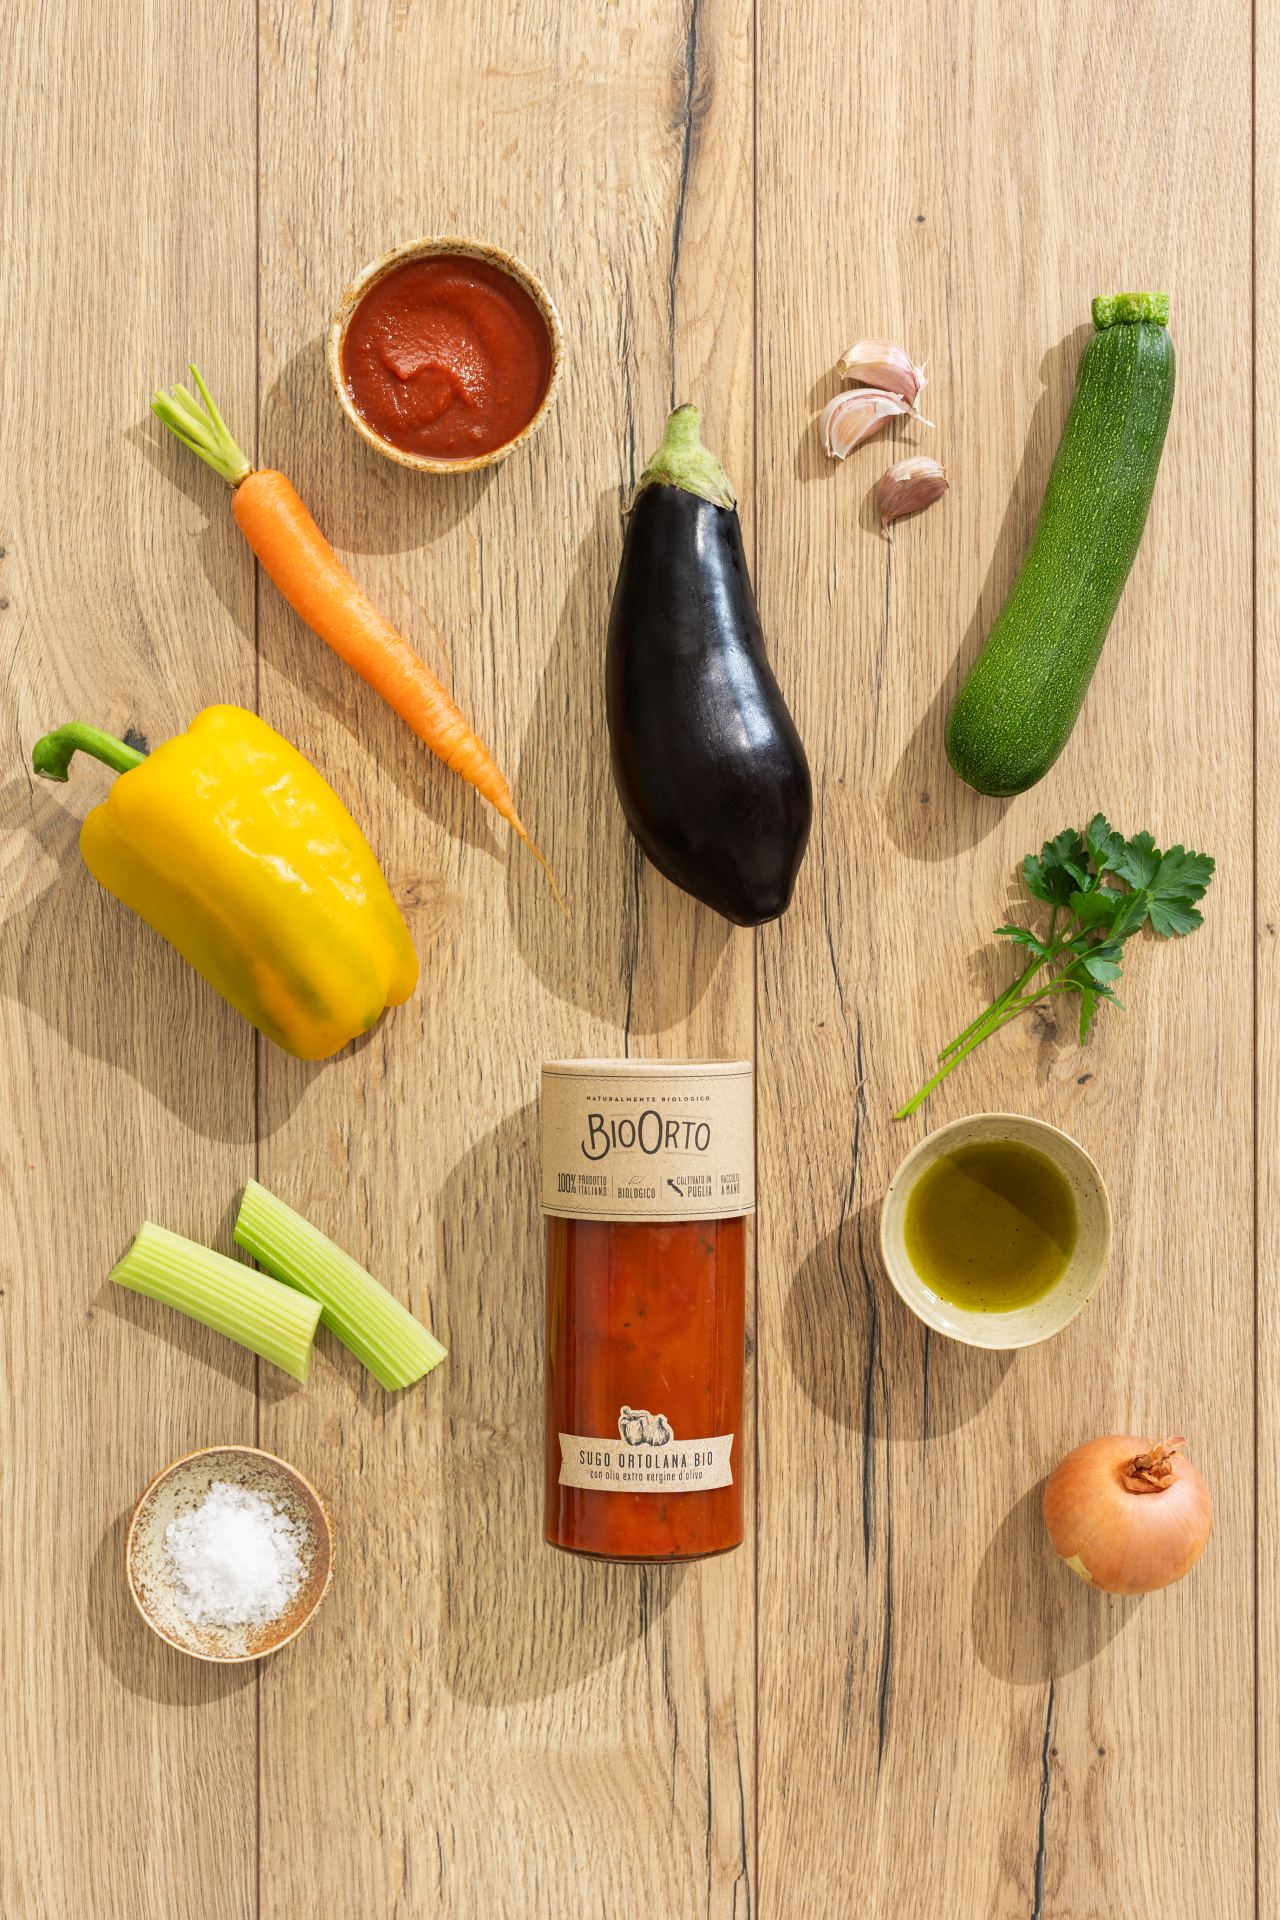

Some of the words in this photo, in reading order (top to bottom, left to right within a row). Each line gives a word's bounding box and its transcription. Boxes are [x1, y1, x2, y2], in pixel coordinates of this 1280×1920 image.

[586, 1095, 656, 1103] NATURALMENTE
[661, 1095, 710, 1103] BIOLOGICO
[557, 1173, 576, 1194] 100%
[578, 1174, 607, 1186] PRODOTTO
[676, 1175, 705, 1186] COLTIVATO
[706, 1175, 712, 1184] IN
[578, 1185, 607, 1197] ITALIANO
[617, 1187, 656, 1199] BIOLOGICO
[687, 1185, 712, 1197] PUGLIA
[721, 1185, 725, 1196] A
[726, 1183, 740, 1195] MANO
[579, 1450, 611, 1467] SUGO
[618, 1454, 687, 1468] ORTOLANA
[694, 1451, 713, 1467] BIO
[590, 1469, 603, 1480] con
[605, 1469, 620, 1481] olio
[622, 1471, 643, 1482] extra
[646, 1470, 676, 1484] vergine
[678, 1469, 703, 1481] d'olivo
